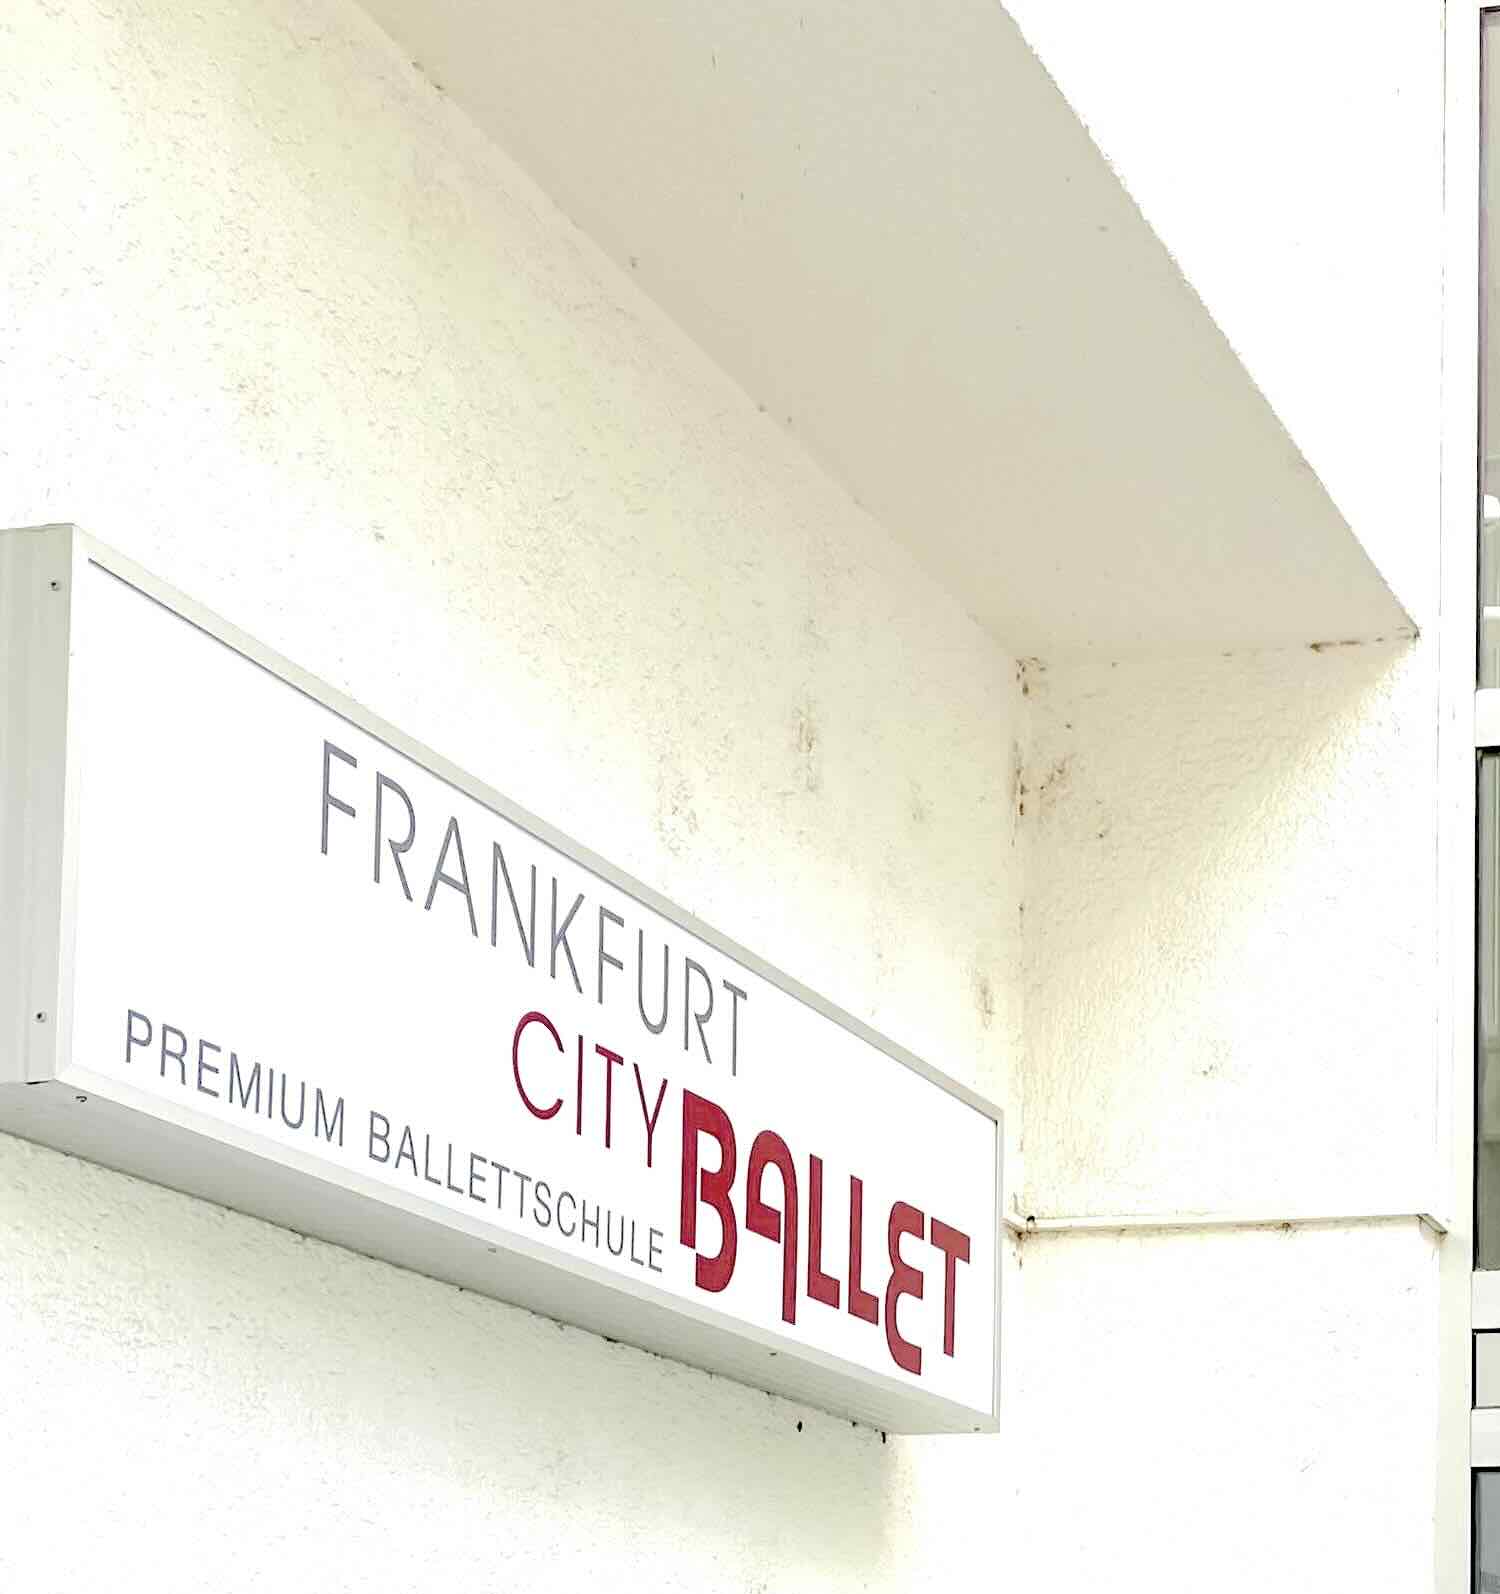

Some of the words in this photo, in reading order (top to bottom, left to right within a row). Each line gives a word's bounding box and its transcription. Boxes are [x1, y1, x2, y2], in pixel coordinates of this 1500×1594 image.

[322, 740, 749, 1078] FRANKFURT
[125, 1008, 347, 1148] PREMIUM
[368, 1110, 665, 1274] BALLETTSCHULE
